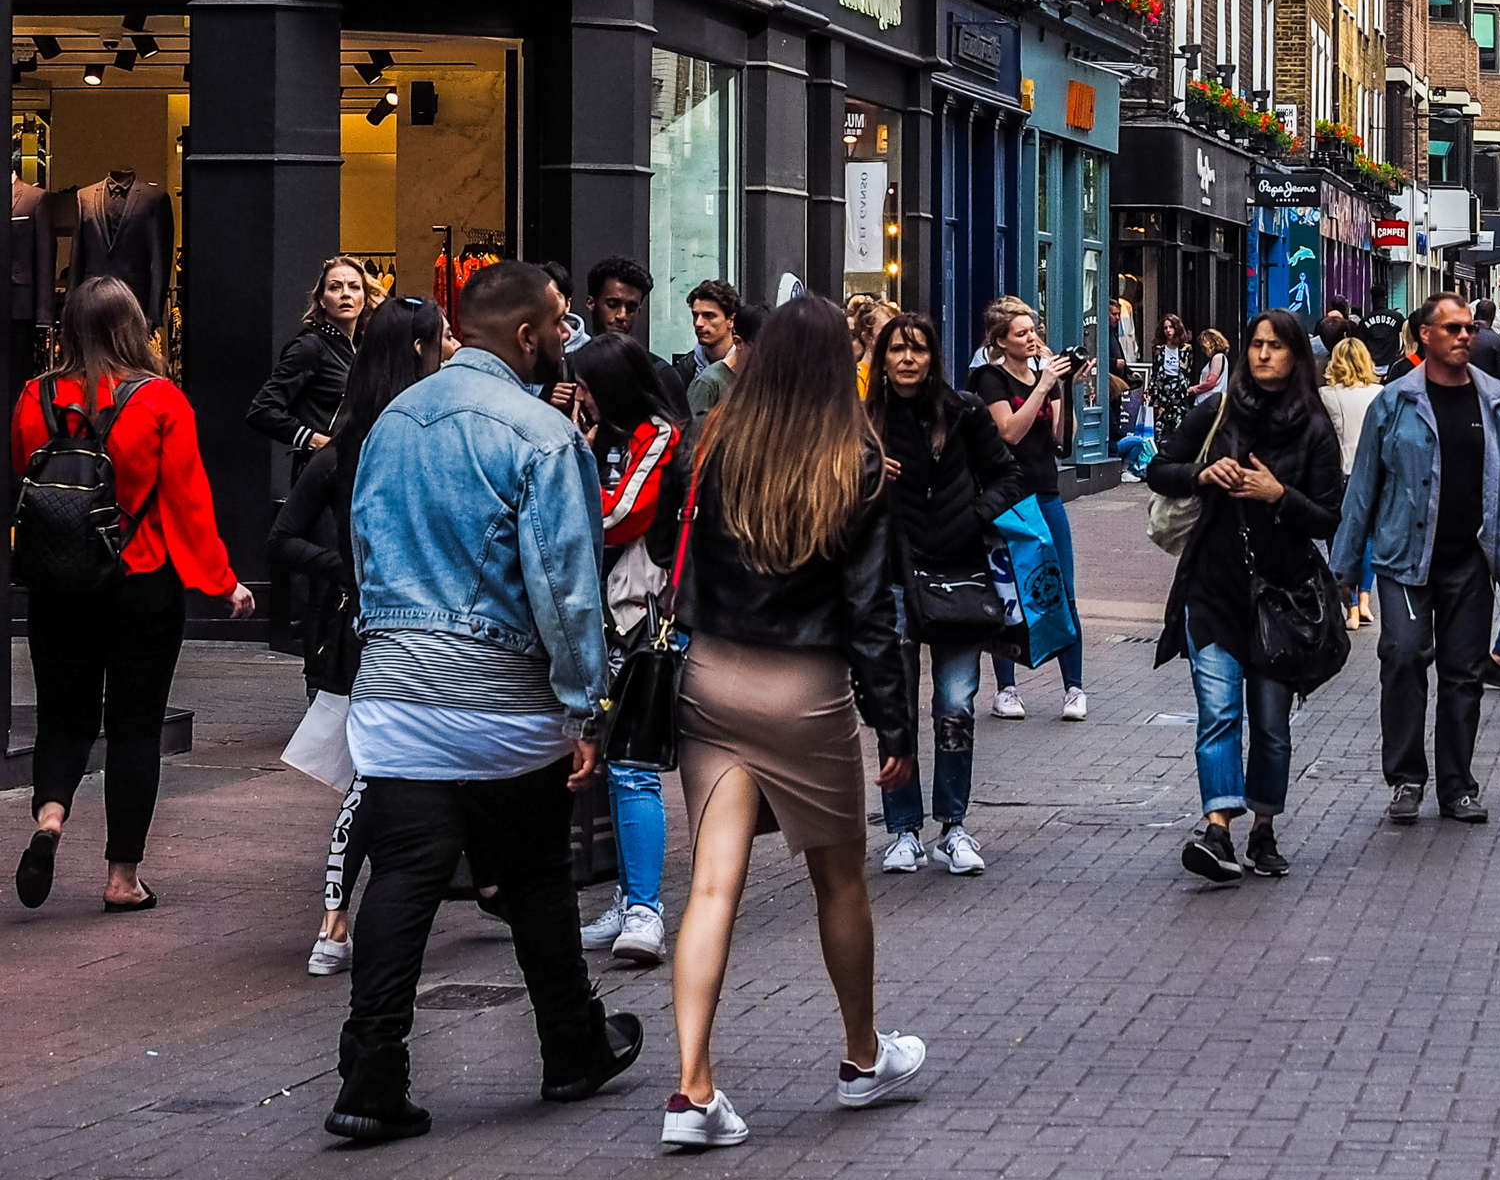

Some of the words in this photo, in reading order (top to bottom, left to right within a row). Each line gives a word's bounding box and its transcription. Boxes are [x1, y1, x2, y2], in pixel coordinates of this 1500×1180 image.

[1258, 179, 1284, 197] Pepe
[1283, 181, 1317, 198] Jeans
[1377, 227, 1406, 239] CAMPER
[1364, 314, 1397, 329] AMBUSH
